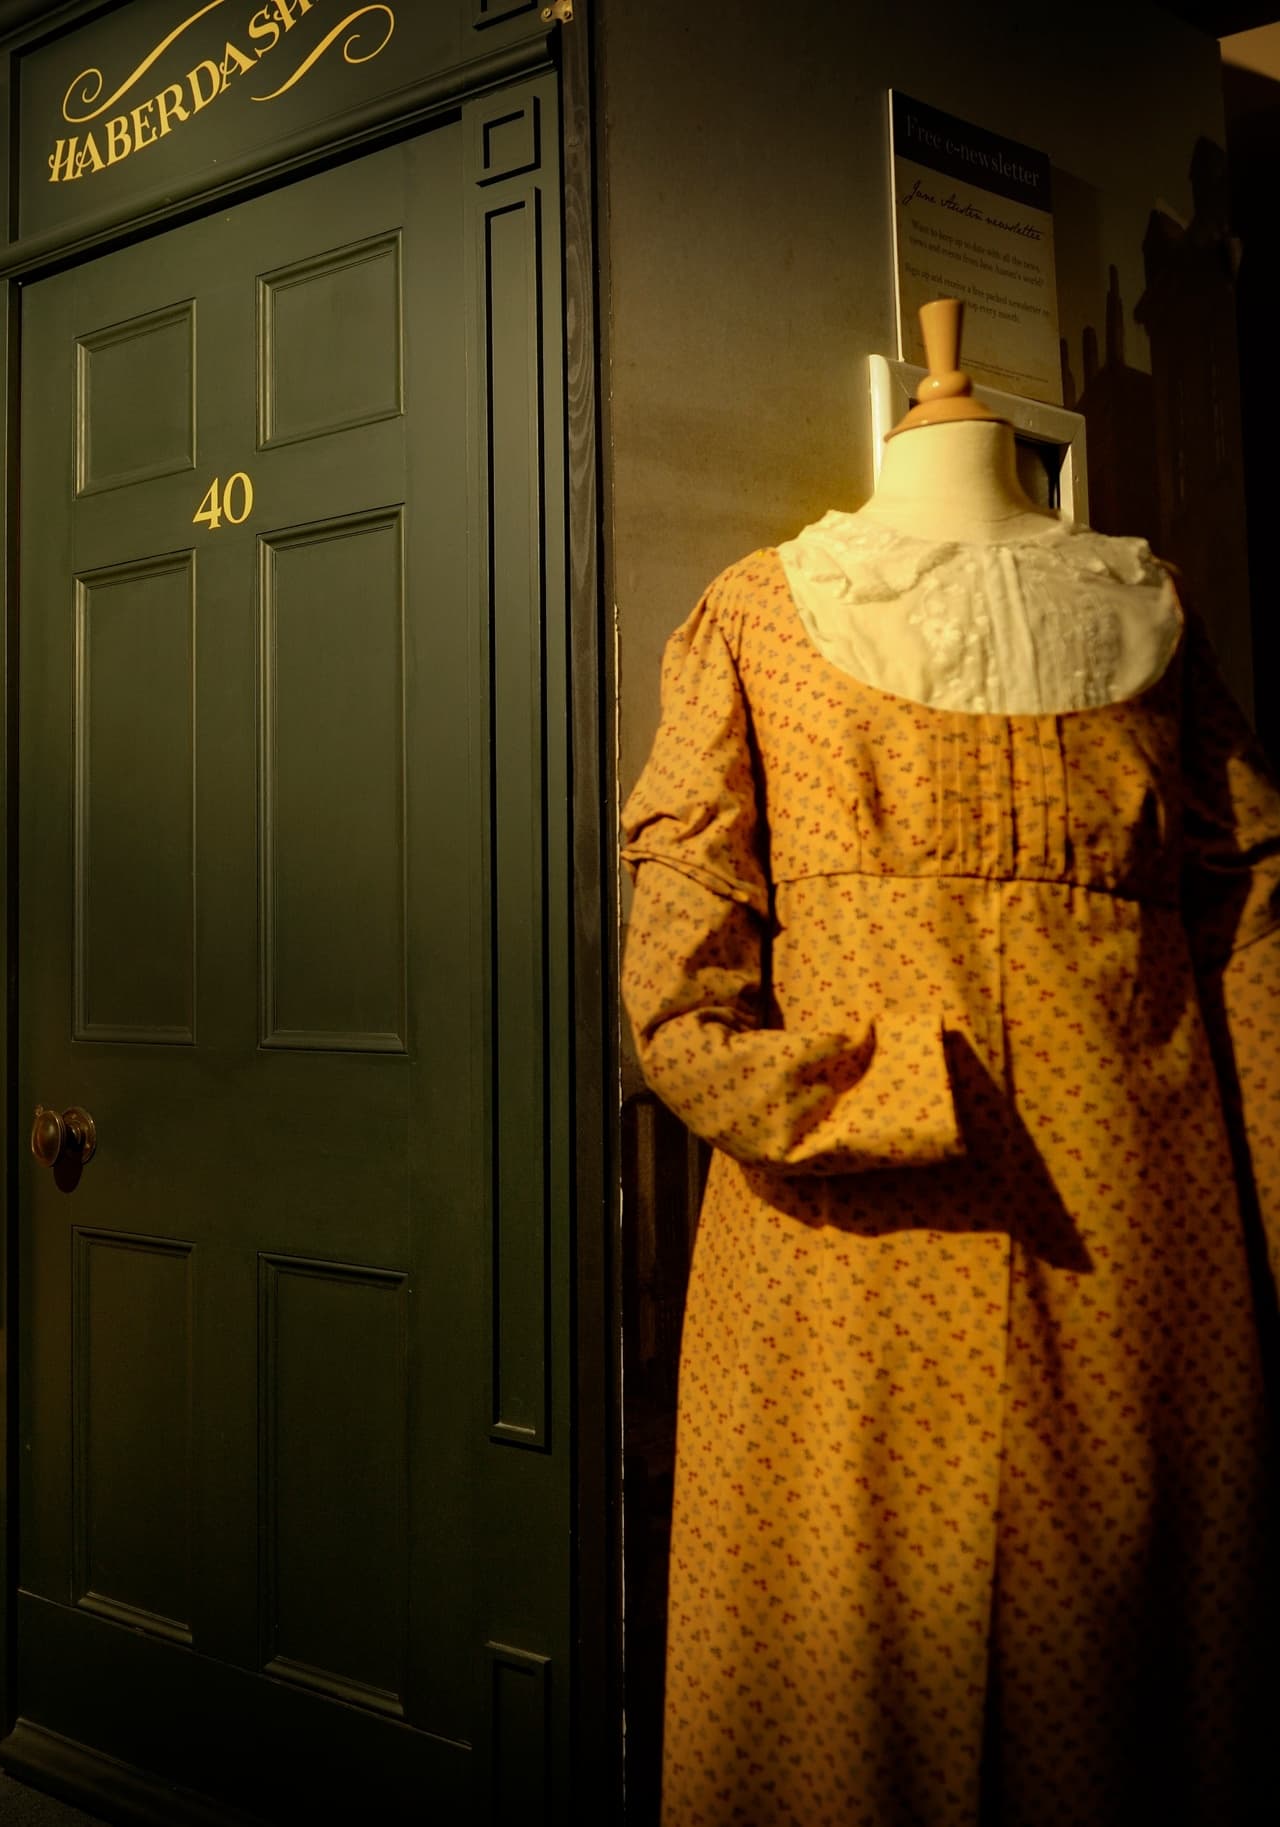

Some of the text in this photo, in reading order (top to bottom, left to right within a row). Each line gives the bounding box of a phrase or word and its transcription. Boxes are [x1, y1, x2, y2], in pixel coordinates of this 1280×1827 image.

[905, 113, 1040, 189] Free e-newsletter
[902, 179, 936, 207] Jane
[192, 471, 254, 530] 40
